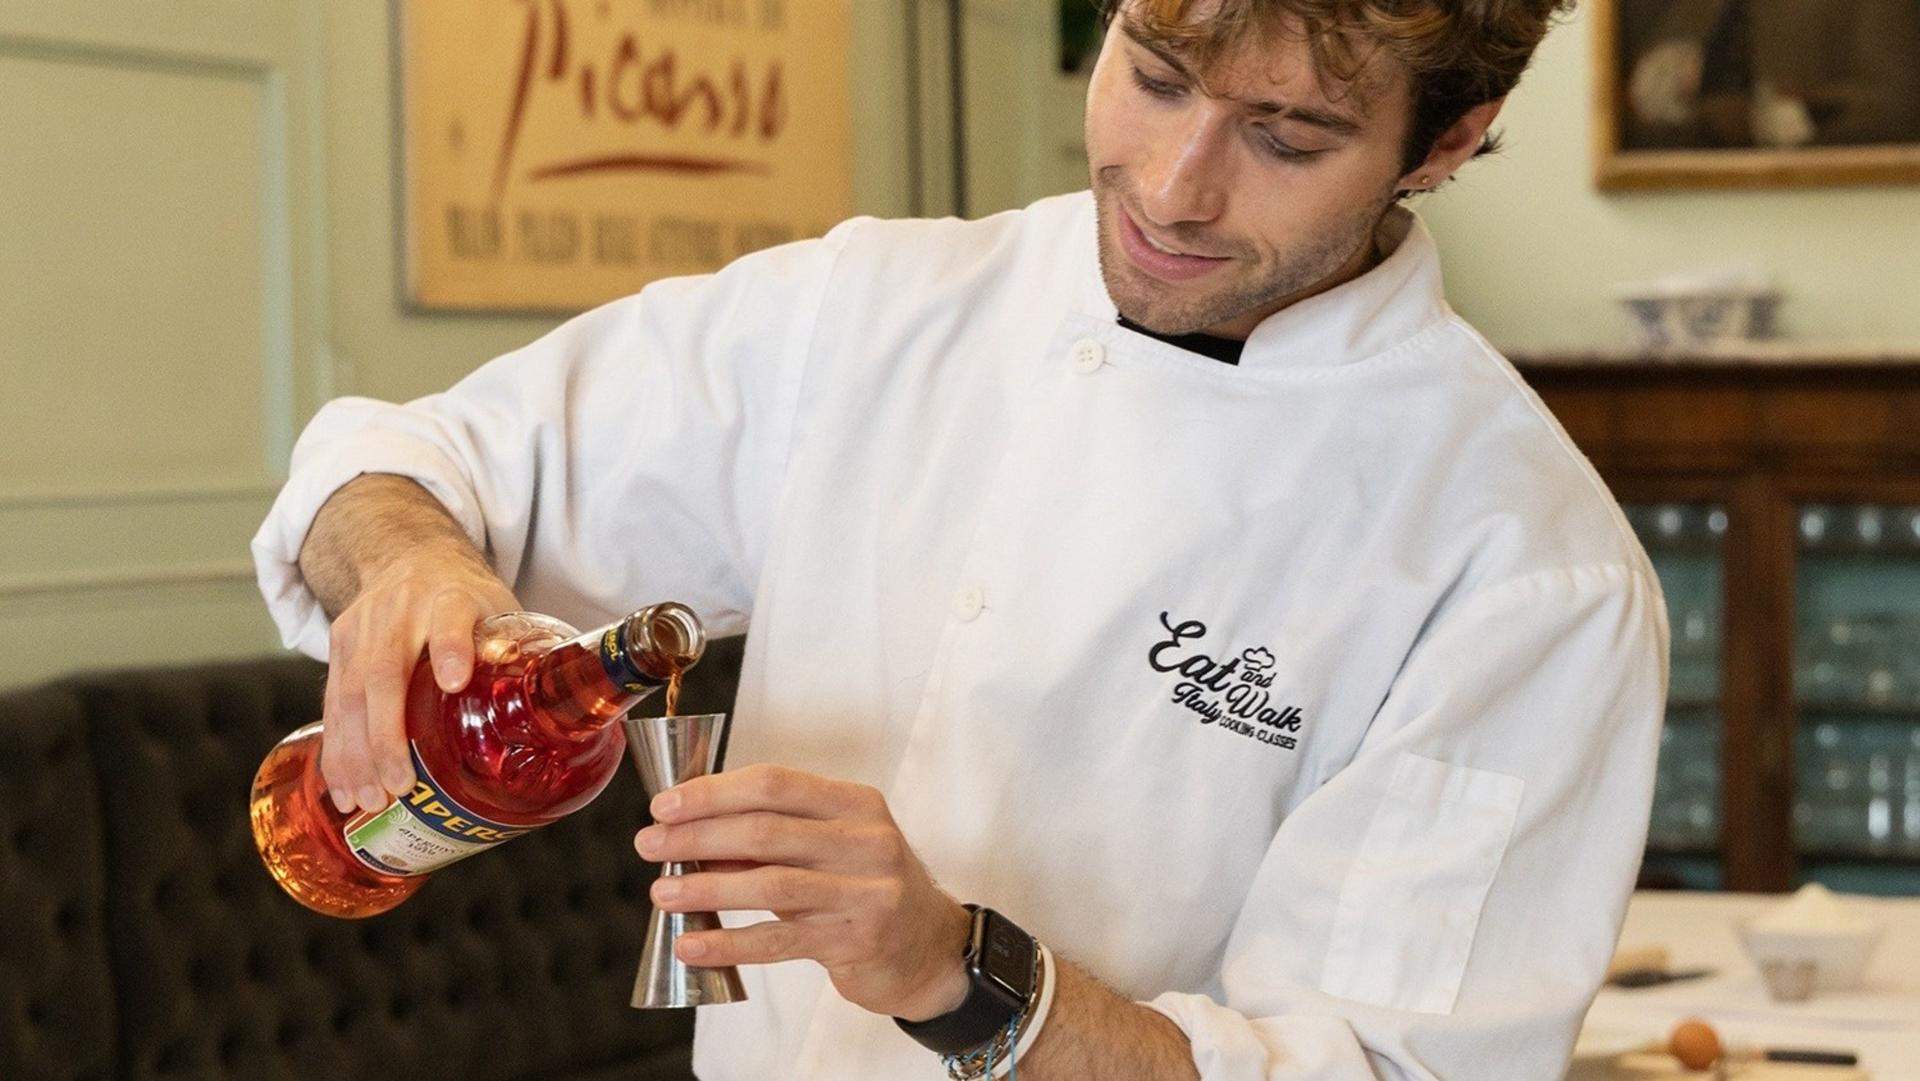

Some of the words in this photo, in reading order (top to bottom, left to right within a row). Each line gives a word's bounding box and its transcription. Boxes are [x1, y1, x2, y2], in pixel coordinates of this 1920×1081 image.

[1148, 611, 1241, 692] Eat
[1240, 671, 1277, 688] and
[1171, 682, 1223, 724] Italy
[1219, 715, 1255, 738] COOKING
[1256, 729, 1297, 750] CLASSES
[1226, 684, 1303, 733] Walk
[410, 781, 530, 841] APERO
